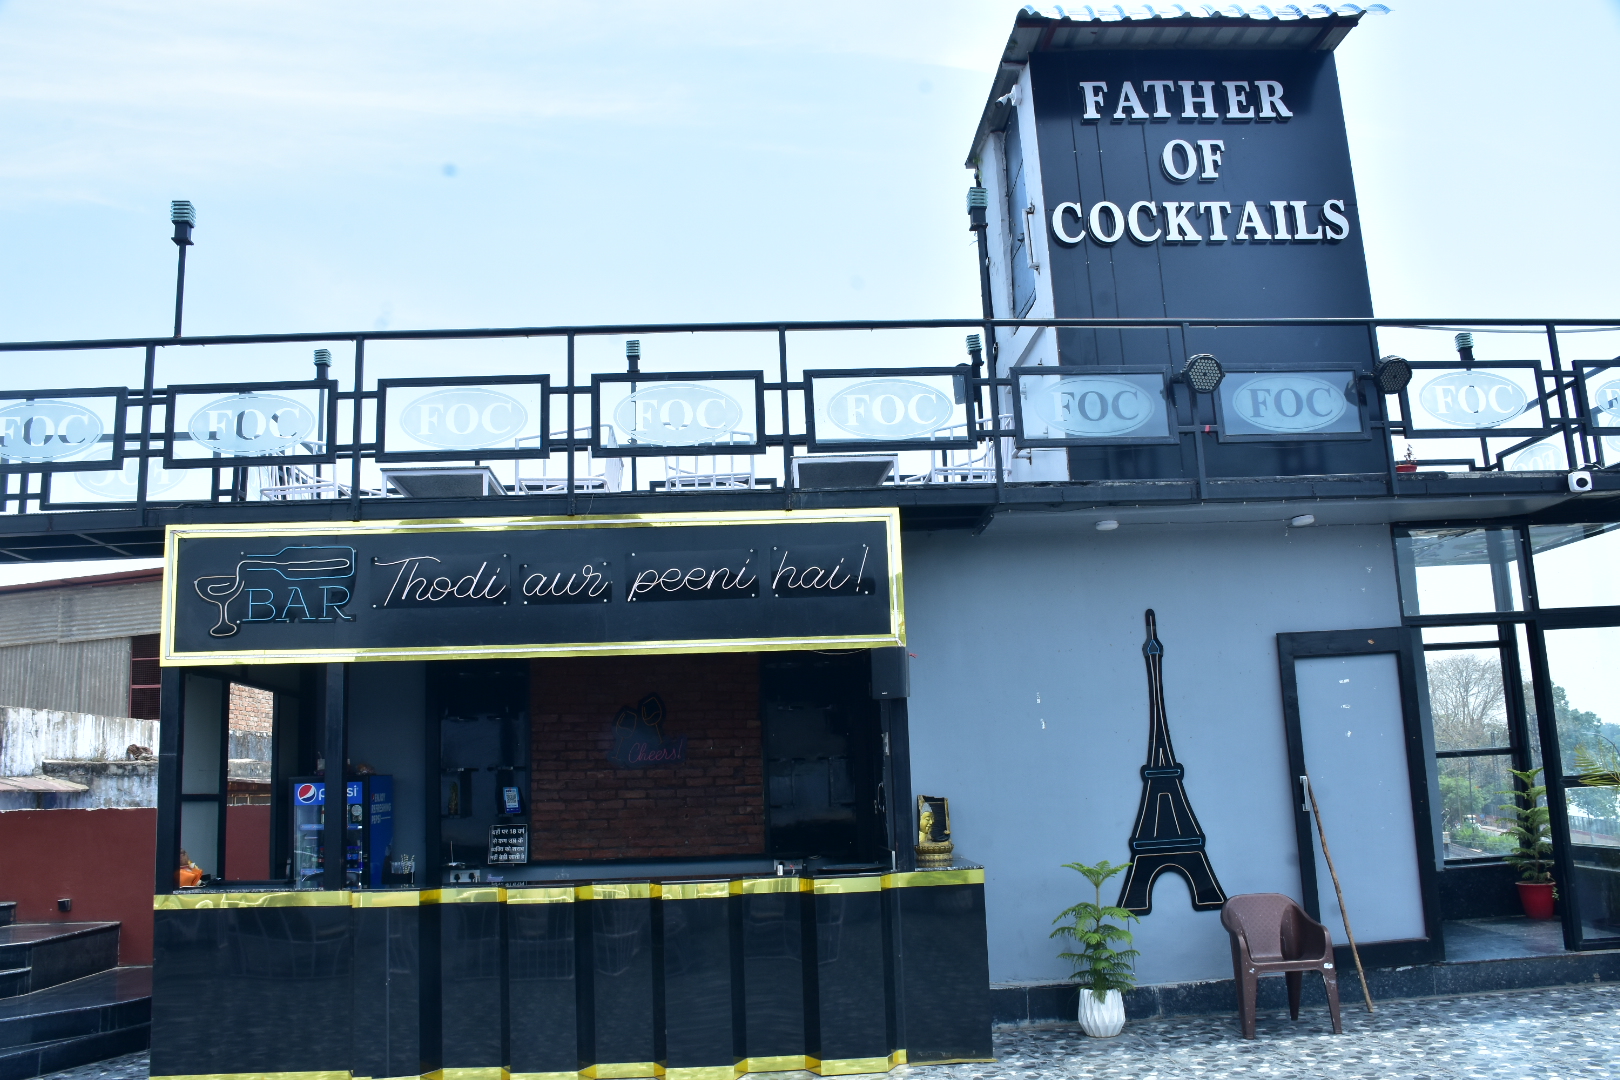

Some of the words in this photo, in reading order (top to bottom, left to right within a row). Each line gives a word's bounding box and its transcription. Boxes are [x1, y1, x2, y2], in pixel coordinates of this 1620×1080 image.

[1079, 80, 1294, 121] FATHER
[1161, 139, 1225, 182] OF
[1051, 199, 1350, 244] COCKTAILS
[632, 397, 728, 432] FOC
[842, 392, 938, 426] FOC
[1050, 389, 1140, 423] FOC
[1247, 386, 1334, 419] FOC
[1432, 383, 1516, 415] FOC
[0, 414, 90, 448] FOC
[205, 407, 301, 441] FOC
[416, 401, 513, 436] FOC
[375, 556, 507, 606] Thodi
[523, 564, 609, 597] aur
[628, 558, 757, 602] peeni
[772, 546, 870, 592] hai!
[242, 585, 352, 622] BAR
[628, 738, 684, 764] Cheers!
